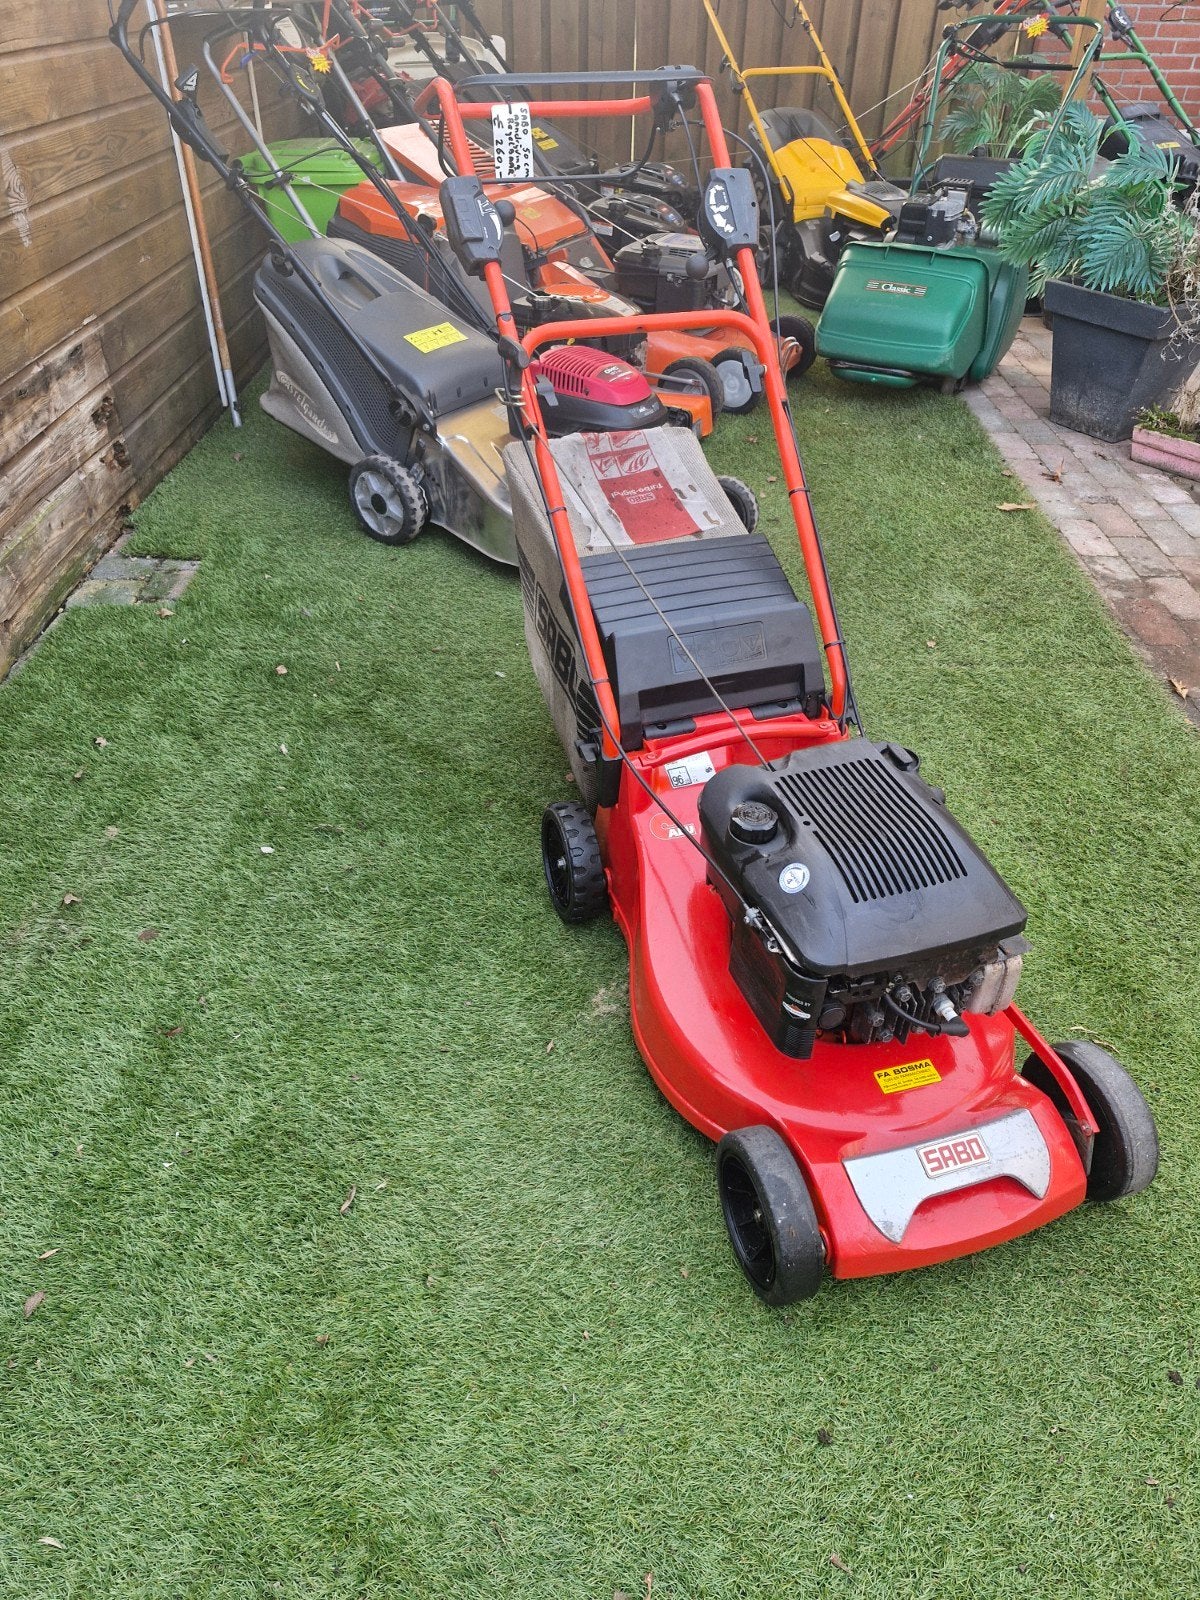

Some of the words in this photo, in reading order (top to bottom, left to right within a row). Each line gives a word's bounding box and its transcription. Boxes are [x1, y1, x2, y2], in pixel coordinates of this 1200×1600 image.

[493, 114, 504, 129] €
[520, 107, 529, 135] SABO
[523, 147, 531, 160] 50
[523, 162, 530, 178] cm
[881, 283, 911, 294] Classic
[611, 482, 664, 499] Turbo-Signal
[628, 492, 655, 504] SABO
[671, 774, 684, 786] 96
[877, 1071, 891, 1079] FA
[893, 1061, 932, 1075] BOSMA
[922, 1137, 985, 1172] SABO
